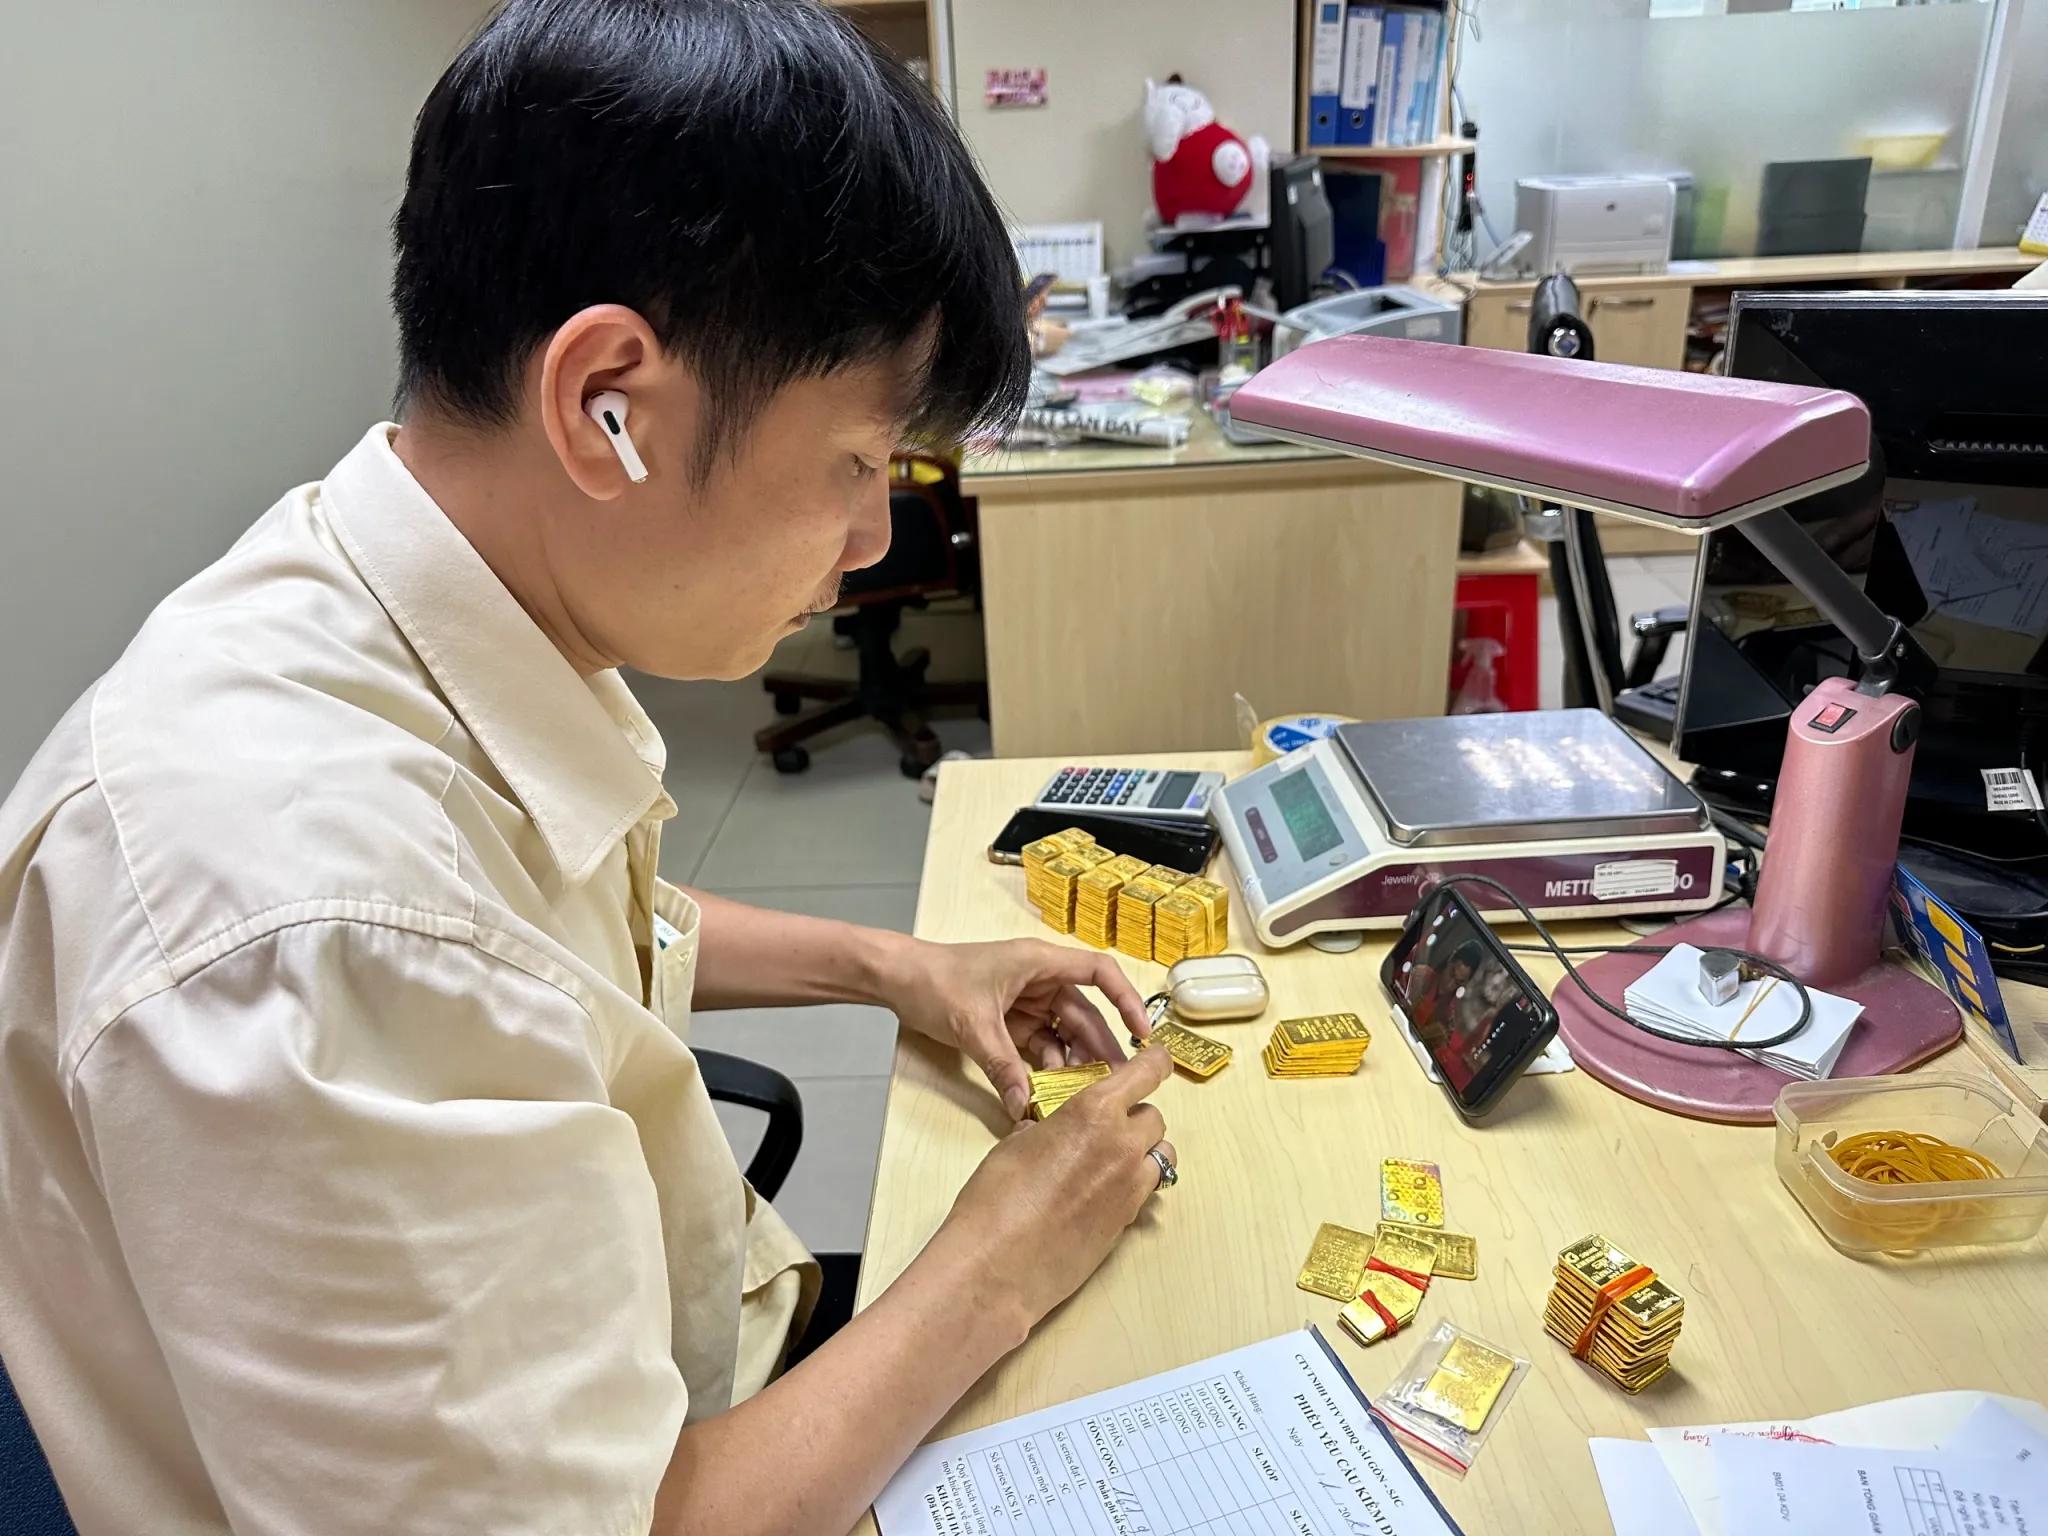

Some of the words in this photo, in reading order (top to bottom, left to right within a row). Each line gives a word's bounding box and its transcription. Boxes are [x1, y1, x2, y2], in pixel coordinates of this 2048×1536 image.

[1381, 873, 1419, 885] Jewelry
[1196, 1388, 1207, 1397] 10
[1233, 1370, 1251, 1393] Khách
[1247, 1393, 1263, 1414] Hàng:
[1228, 1404, 1247, 1430] VÀNG
[1055, 1431, 1066, 1442] Số
[1288, 1427, 1304, 1447] Ngày
[1295, 1354, 1309, 1370] CTY
[1307, 1372, 1328, 1396] TNHH
[1326, 1397, 1340, 1416] MTV
[1386, 1489, 1404, 1505] SJC
[1022, 1441, 1035, 1452] Số
[1319, 1431, 1342, 1456] YÊU
[990, 1452, 1001, 1463] Số
[1060, 1443, 1074, 1464] series
[1027, 1453, 1040, 1475] series
[1070, 1465, 1081, 1478] đạt
[1252, 1447, 1263, 1460] SL
[1262, 1460, 1278, 1481] MÓP
[994, 1464, 1007, 1486] series
[1772, 1472, 1784, 1491] BM01
[1857, 1470, 1869, 1486] BAN
[1037, 1476, 1049, 1493] móp
[1059, 1483, 1071, 1494] 5C
[1076, 1478, 1086, 1490] 1L
[936, 1484, 956, 1521] KHÁCH
[956, 1463, 969, 1478] Quý
[963, 1479, 977, 1502] khách
[972, 1503, 980, 1516] vui
[976, 1516, 987, 1535] lòng
[1003, 1486, 1018, 1507] MCS
[1025, 1494, 1037, 1505] 5C
[1045, 1494, 1055, 1506] 1L
[1096, 1479, 1111, 1500] Phần
[1104, 1501, 1118, 1514] ghi
[924, 1494, 937, 1509] (Đã
[931, 1509, 944, 1530] kiểm
[990, 1505, 1003, 1516] 5C
[1012, 1509, 1022, 1521] 1L
[1290, 1510, 1302, 1523] SL
[964, 1521, 973, 1535] sau
